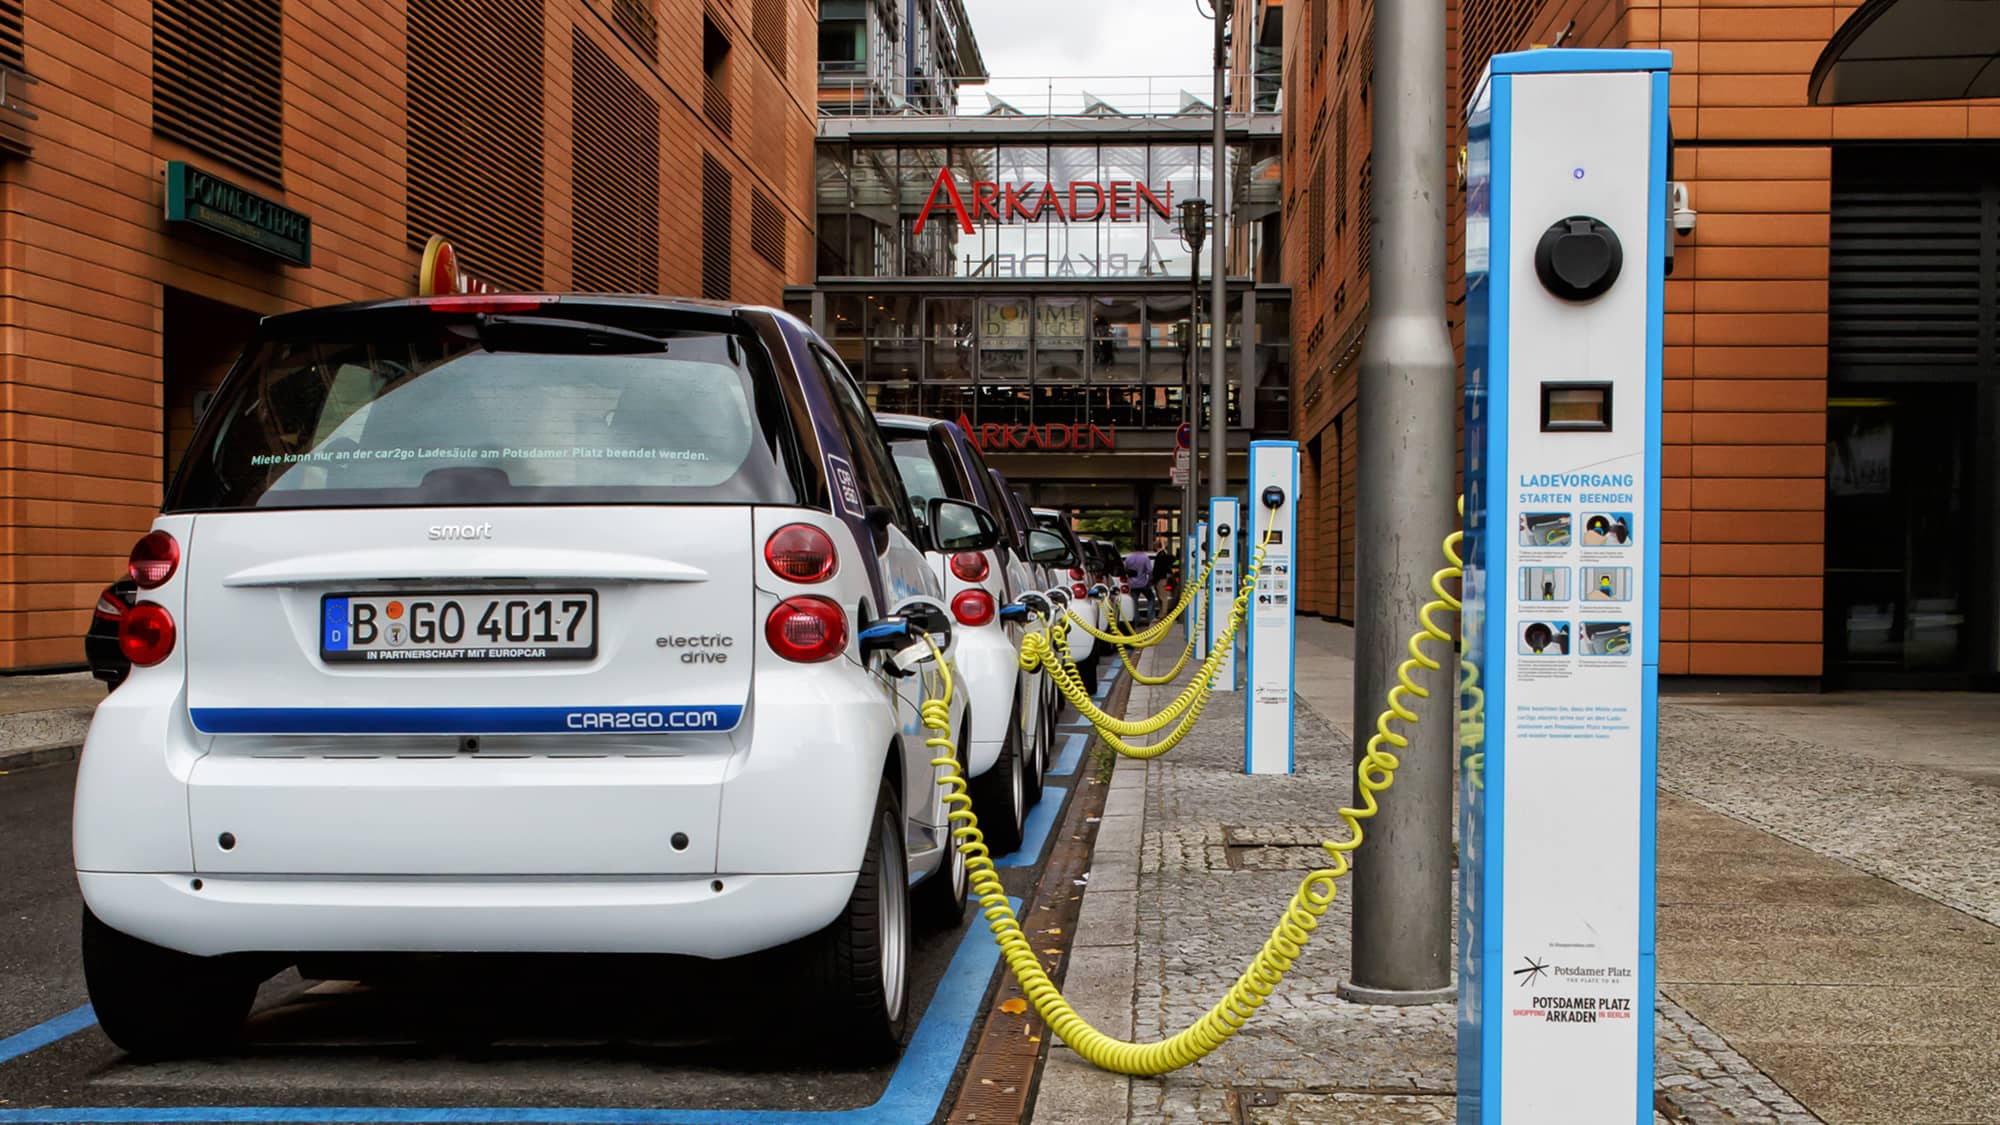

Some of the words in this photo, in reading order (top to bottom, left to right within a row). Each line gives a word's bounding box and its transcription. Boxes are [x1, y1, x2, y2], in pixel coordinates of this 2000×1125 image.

[913, 166, 1172, 235] ARKADEN
[956, 413, 1115, 457] ARKADEN
[251, 455, 281, 466] Miete
[283, 453, 310, 463] kann
[314, 451, 332, 461] nur
[335, 450, 350, 460] an
[353, 448, 371, 460] der
[375, 448, 415, 461] car2go
[418, 448, 478, 458] Ladesäule
[480, 449, 499, 459] am
[502, 448, 568, 459] Potsdamer
[572, 447, 602, 459] Platz
[606, 448, 656, 459] beendet
[659, 450, 710, 461] werden.
[1520, 474, 1633, 487] LADEVORGANG
[1520, 493, 1572, 503] STARTEN
[1580, 493, 1633, 503] BEENDEN
[428, 521, 493, 540] smart
[353, 603, 378, 644] B
[410, 601, 465, 644] GO
[477, 600, 588, 643] 4017
[331, 630, 341, 642] D
[656, 634, 733, 648] electric
[367, 649, 377, 660] IN
[379, 649, 464, 660] PARTNERSCHAFT
[467, 648, 485, 659] MIT
[488, 648, 546, 659] EUROPCAR
[680, 651, 728, 664] drive
[567, 711, 717, 728] CAR2GO.COM
[1554, 966, 1605, 977] Potsdamer
[1607, 966, 1631, 977] Platz
[1532, 996, 1596, 1009] POTSDAMER
[1598, 998, 1631, 1010] PLATZ
[1546, 1010, 1597, 1023] ARKADEN
